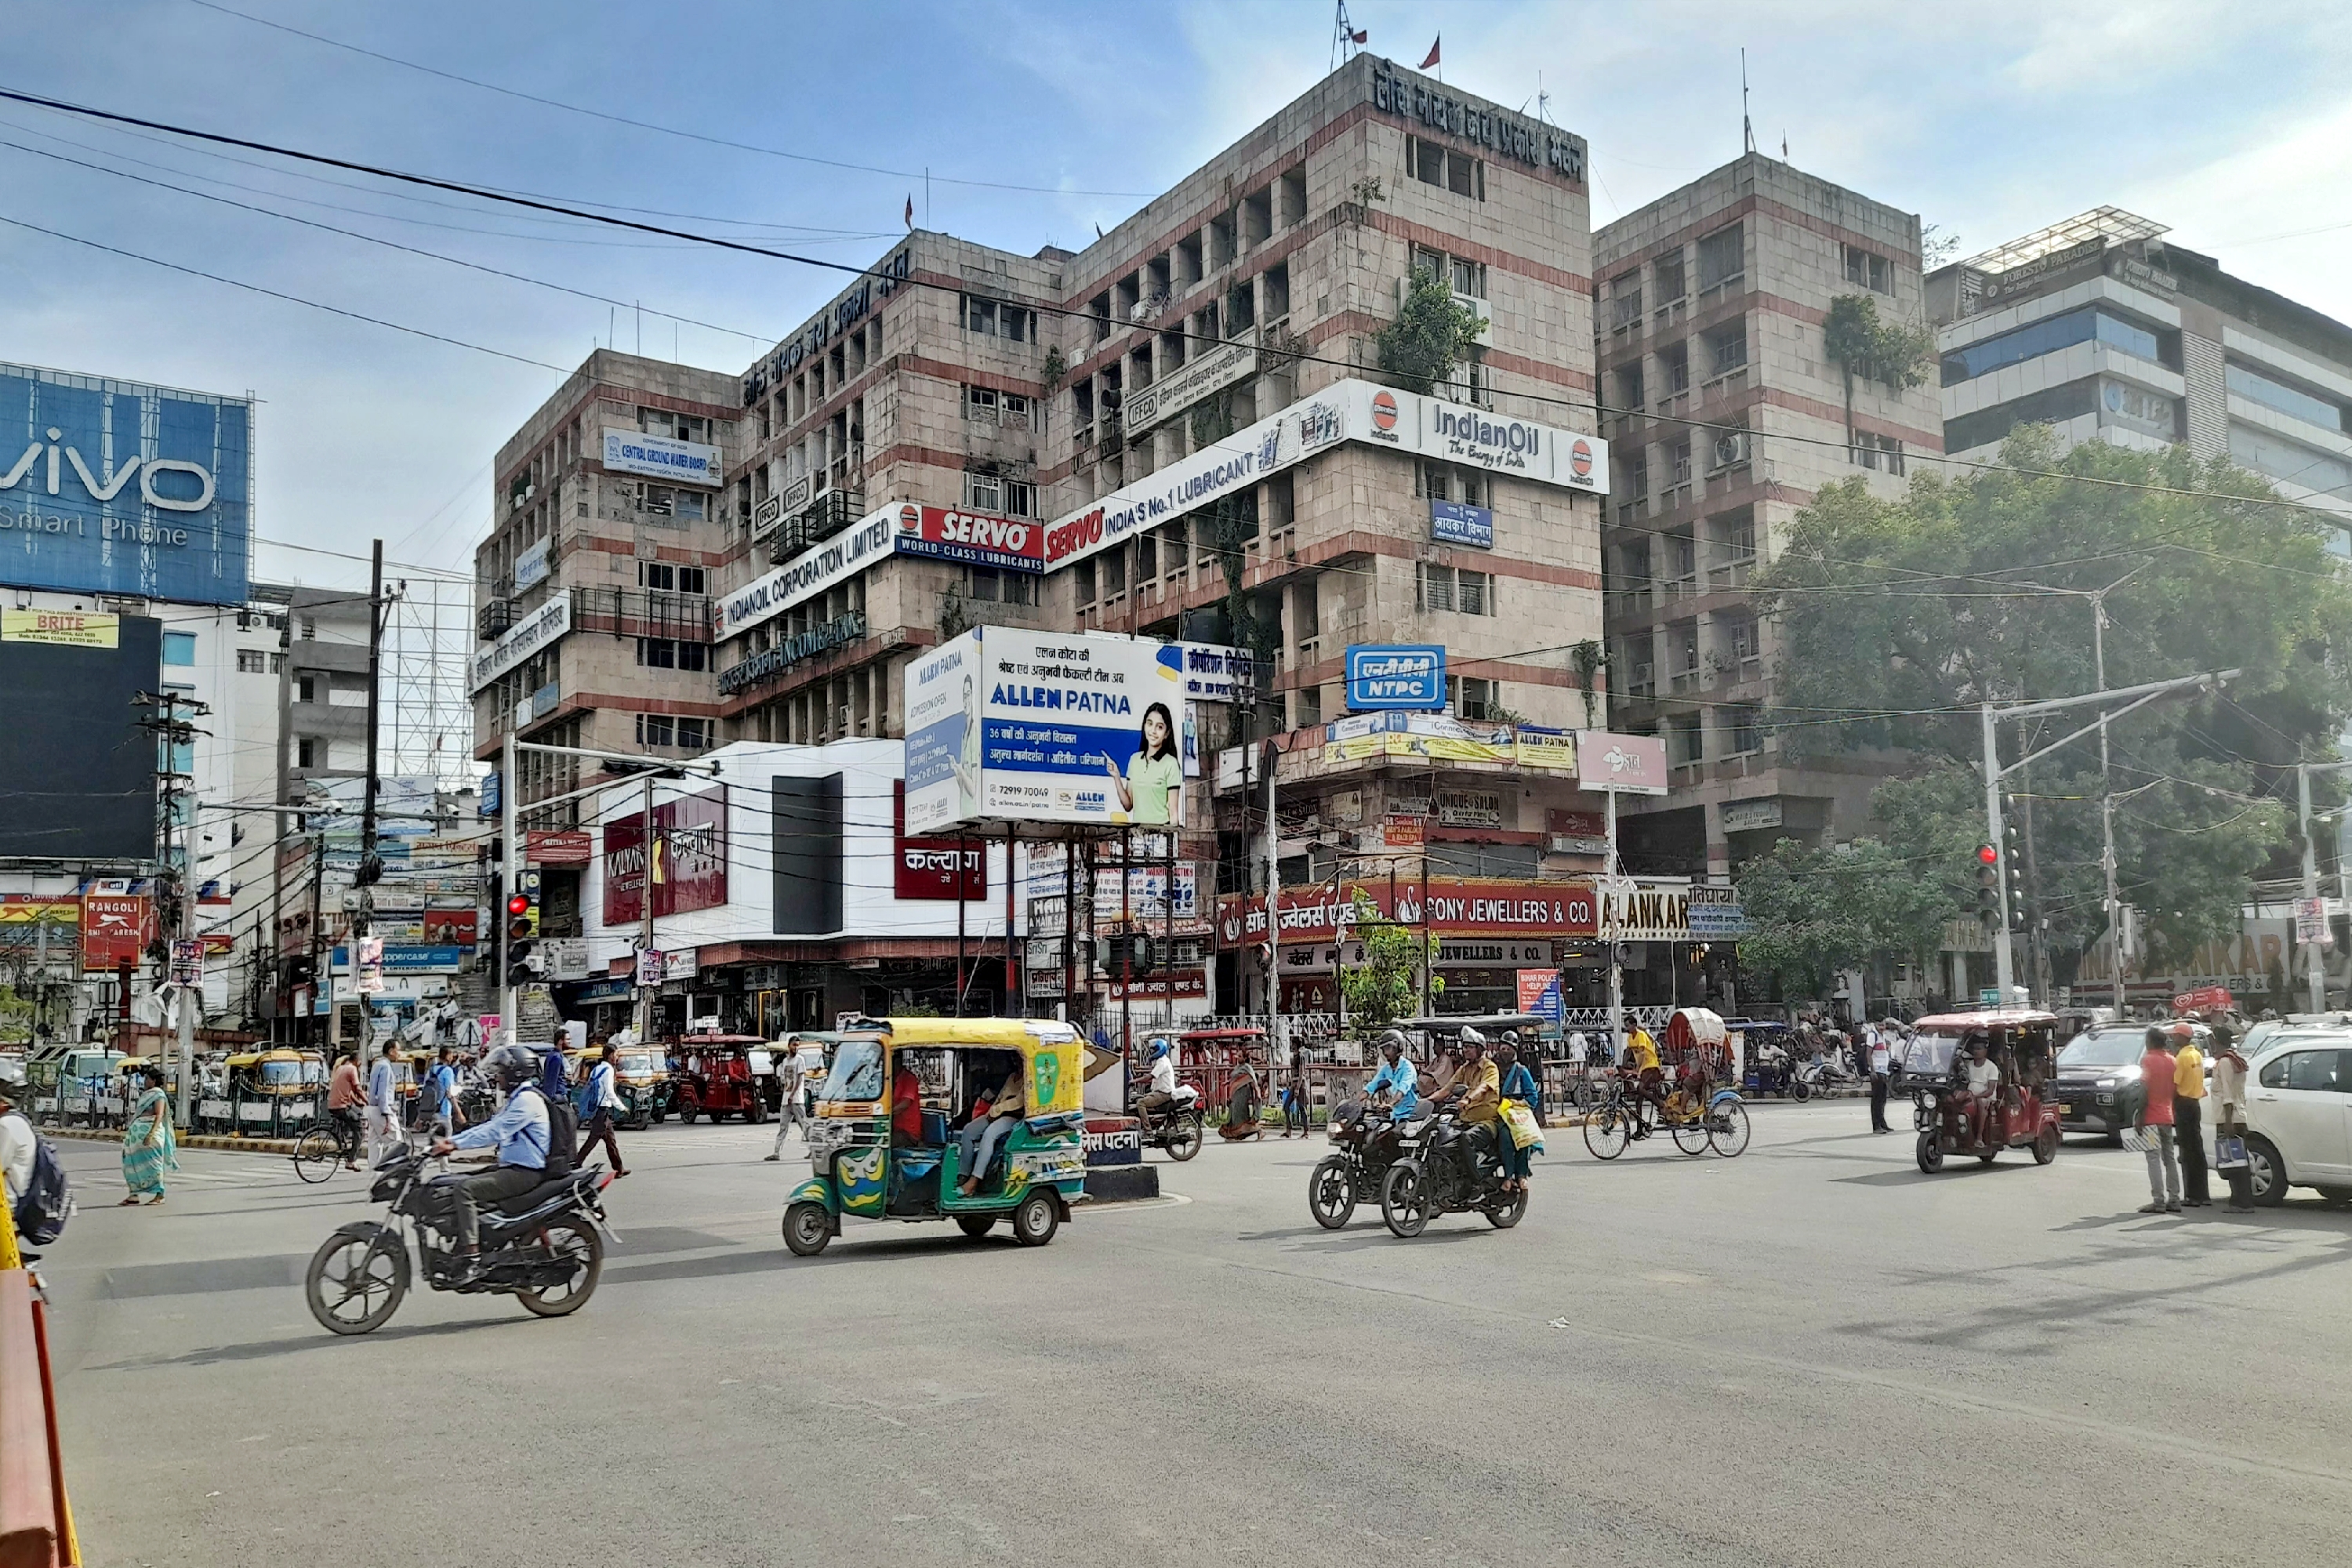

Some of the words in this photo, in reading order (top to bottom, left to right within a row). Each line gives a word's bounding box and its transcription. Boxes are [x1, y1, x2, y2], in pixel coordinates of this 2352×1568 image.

[1132, 398, 1155, 422] IFFCO
[1434, 404, 1539, 456] IndianOil
[622, 445, 646, 460] CENTRAL
[648, 450, 669, 465] GROUND
[670, 452, 688, 469] WATER
[689, 456, 706, 471] BOARD
[1449, 439, 1465, 454] The
[1468, 445, 1494, 466] Energy
[1496, 451, 1504, 467] of
[1505, 452, 1526, 468] India
[0, 426, 216, 511] vivo
[787, 485, 807, 506] IFFCO
[758, 503, 776, 524] IFFCO
[1046, 506, 1105, 563] SERVO
[1105, 502, 1146, 535] INDIA'S
[1178, 452, 1254, 503] LUBRICANT
[0, 506, 85, 536] Smart
[103, 517, 188, 546] Phone
[941, 511, 1029, 551] SERVO
[1435, 517, 1465, 534] आयकर
[1467, 518, 1492, 539] विभाग
[902, 539, 976, 560] WORLD-CLASS
[981, 552, 1042, 570] LUBRICANTS
[728, 585, 771, 625] INDIANOIL
[772, 543, 844, 601] CORPORATION
[846, 517, 890, 563] LIMITED
[38, 615, 85, 631] BRITE
[1036, 647, 1056, 659] एलन
[1058, 646, 1076, 660] कोटा
[1079, 647, 1090, 662] की
[919, 660, 940, 687] ALLEN
[941, 649, 962, 675] PATNA
[1017, 662, 1029, 674] एवं
[1031, 664, 1061, 681] अनुभवी
[1094, 668, 1109, 683] टीम
[1112, 673, 1124, 684] अब
[1362, 658, 1430, 677] एनटीपीसी
[990, 682, 1062, 710] ALLEN
[1066, 690, 1131, 715] PATNA
[1368, 681, 1424, 696] NTPC
[910, 699, 934, 719] ADMISSION
[934, 691, 947, 707] OPEN
[989, 728, 999, 739] 36
[1014, 726, 1025, 740] की
[1026, 729, 1051, 745] अनुभवी
[1053, 730, 1077, 744] विरासत
[1519, 733, 1543, 745] ALLEN
[1544, 736, 1570, 747] PATNA
[989, 748, 1011, 763] अतुल्य
[1080, 752, 1105, 766] परिणाम
[999, 786, 1022, 795] 72919
[1024, 786, 1049, 797] 70049
[1076, 791, 1105, 802] ALLEN
[1439, 793, 1468, 808] UNIQUE
[1474, 795, 1500, 811] SALON
[88, 902, 137, 913] RANGOLI
[1034, 900, 1068, 916] HAVE
[1247, 905, 1268, 934] सोन
[1278, 898, 1326, 930] ज्वेलर्स
[1427, 897, 1465, 921] SONY
[1468, 898, 1548, 924] JEWELLERS
[1554, 901, 1564, 924] &
[1569, 902, 1592, 924] CO.
[1036, 914, 1053, 927] HAIR
[111, 928, 140, 937] ARESH
[383, 951, 428, 963] uppercase
[1439, 946, 1503, 961] JEWELLERS
[1510, 946, 1518, 960] &
[1524, 946, 1541, 960] CO.
[1538, 974, 1556, 982] POLICE
[1104, 1130, 1139, 1150] पटना
